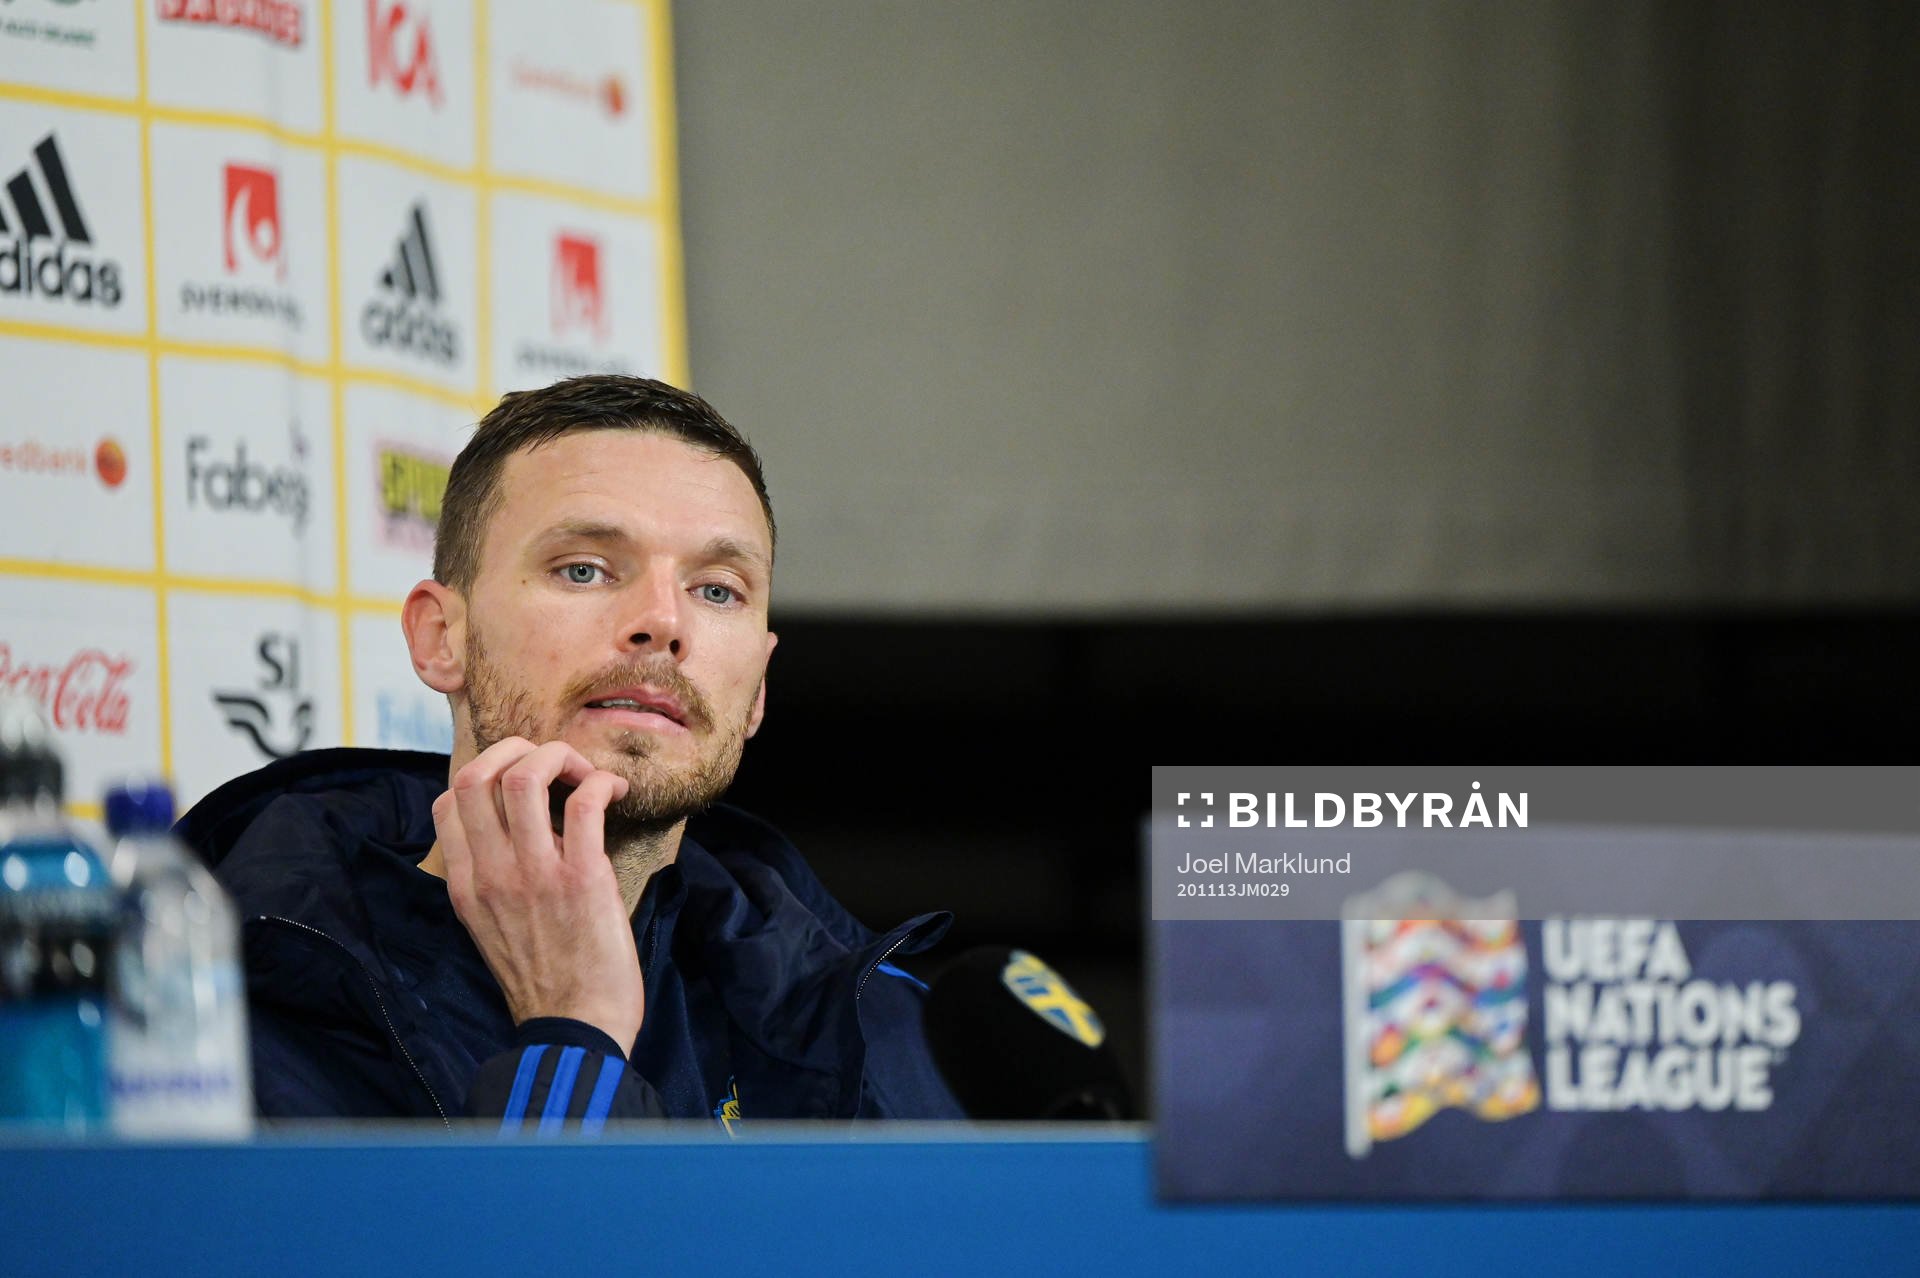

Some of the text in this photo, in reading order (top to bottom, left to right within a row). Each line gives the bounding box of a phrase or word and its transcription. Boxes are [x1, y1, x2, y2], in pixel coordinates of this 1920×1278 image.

[0, 236, 123, 310] didas
[1543, 915, 1692, 982] UEFA
[1544, 981, 1800, 1048] NATIONS
[1546, 1046, 1775, 1112] LEAGUE
